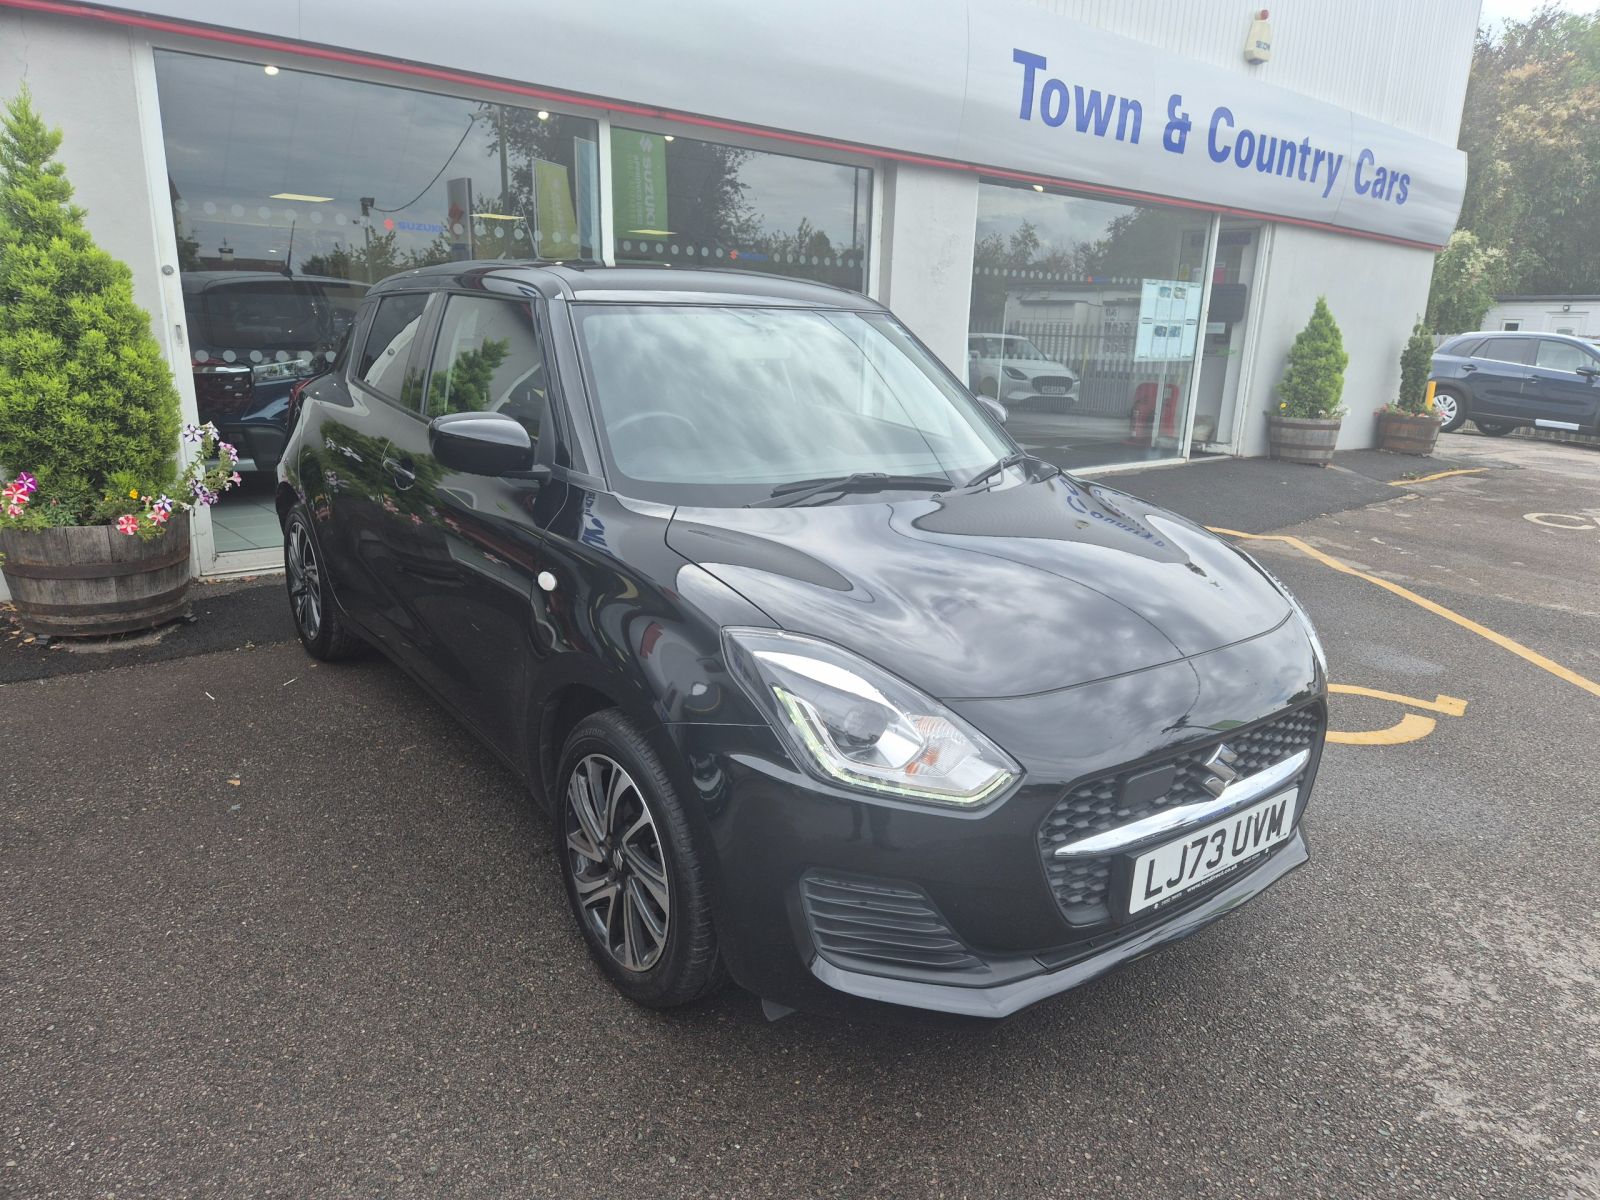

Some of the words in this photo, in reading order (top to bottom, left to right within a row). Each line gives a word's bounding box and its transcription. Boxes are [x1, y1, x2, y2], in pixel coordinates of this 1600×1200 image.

[1013, 47, 1142, 145] Town
[1163, 94, 1192, 154] &
[1207, 106, 1344, 198] Country
[1354, 148, 1411, 206] Cars
[643, 155, 655, 226] SUZUKI
[1144, 828, 1226, 900] LJ73
[1232, 799, 1287, 857] UVM
